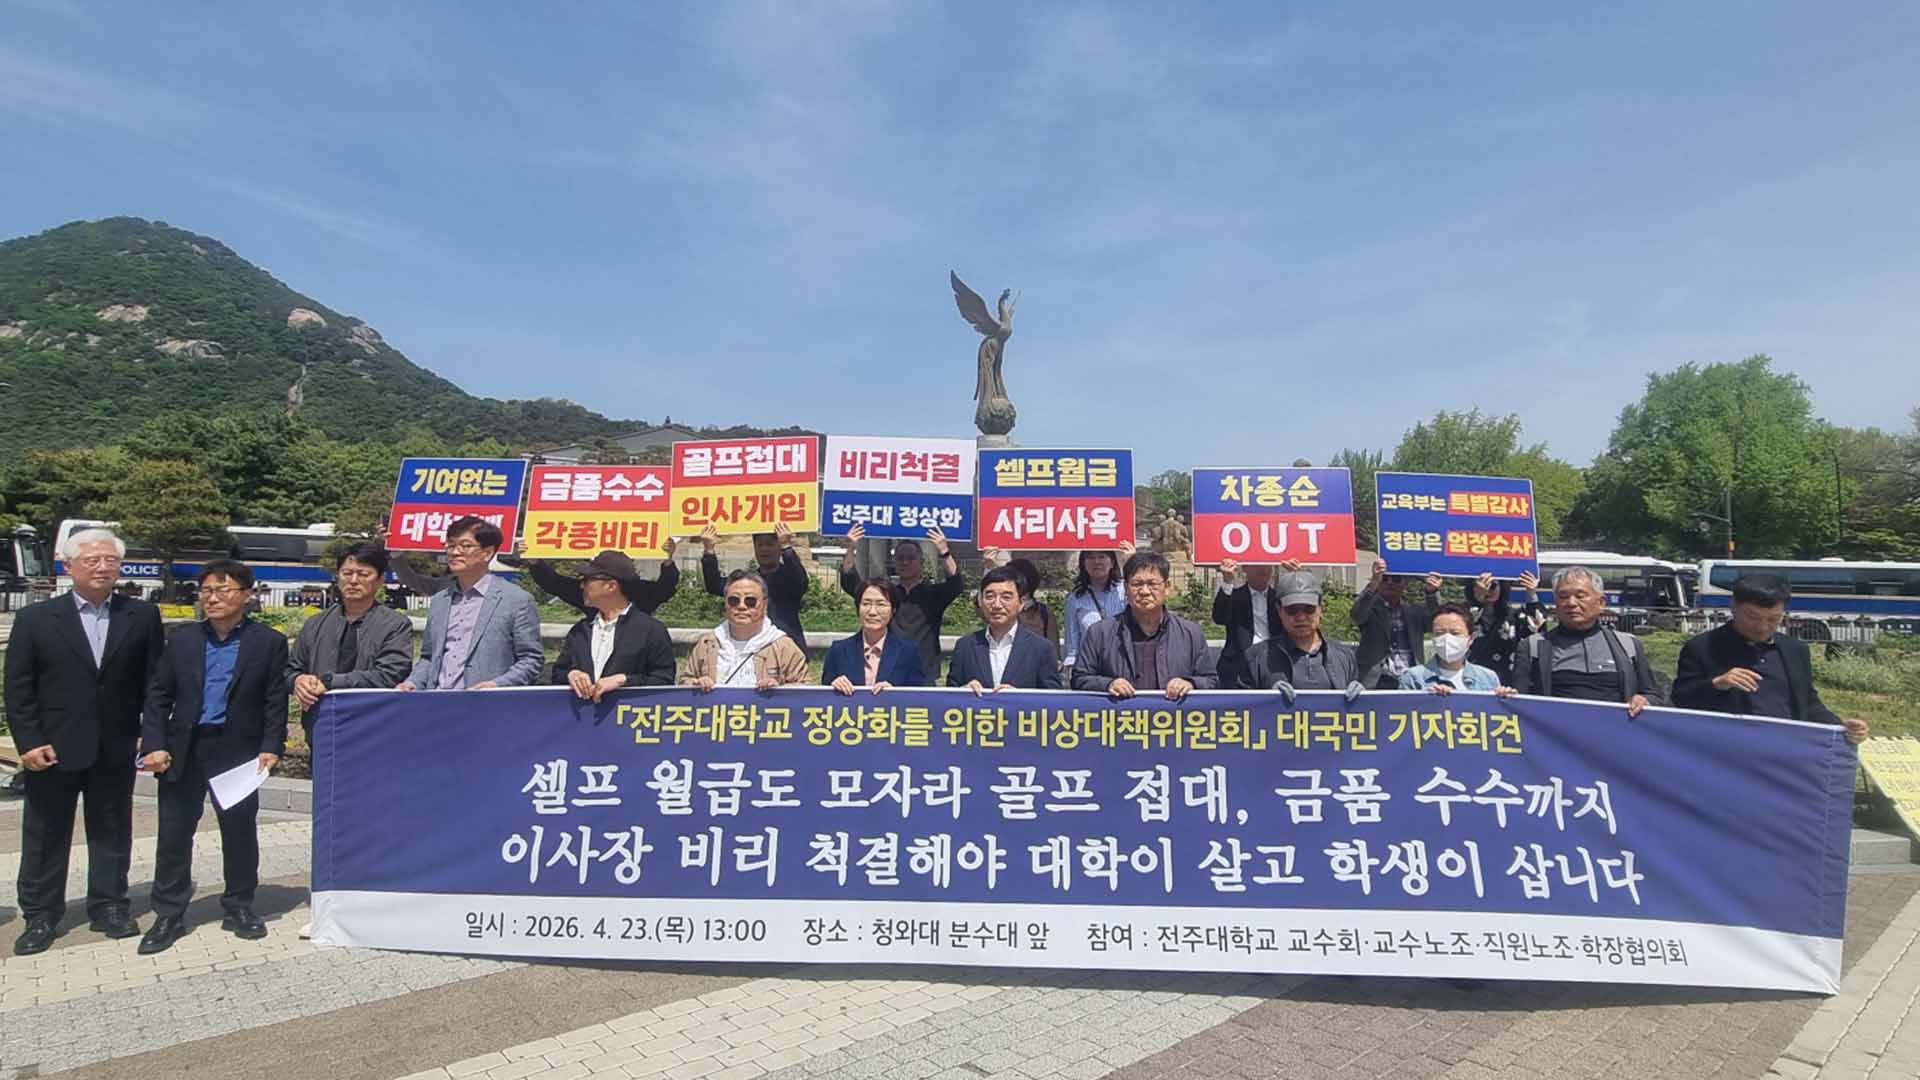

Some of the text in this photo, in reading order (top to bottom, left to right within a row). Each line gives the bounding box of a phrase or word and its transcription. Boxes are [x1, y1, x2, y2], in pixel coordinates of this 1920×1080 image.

[683, 443, 807, 477] 골프접대
[840, 451, 959, 483] 비리척결
[995, 458, 1116, 486] 셀프월급
[412, 469, 507, 495] 기여없는
[541, 474, 664, 501] 금품수수
[1221, 476, 1320, 506] 차종순
[682, 493, 805, 526] 인사개입
[832, 504, 962, 530] 전주대 정상화
[1382, 494, 1528, 515] 교육부는 특별감사
[400, 512, 504, 543] 대학
[536, 521, 658, 552] 각종비리
[994, 507, 1119, 539] 사리사욕
[1222, 522, 1325, 553] OUT
[1384, 531, 1532, 557] 경찰은 엄정수사
[121, 565, 159, 575] OLICE
[802, 706, 932, 746] 정상화를
[942, 708, 1008, 746] 위한
[1278, 711, 1377, 751] 대국민
[1388, 710, 1521, 753] 기자회견
[522, 759, 1616, 834] 셀프 월급도 모자라 골프 접대, 금품 수수까지
[502, 825, 1644, 904] 이사장 비리 척결해야 대학이 살고 학생이 삽니다
[466, 912, 504, 938] 일시
[525, 916, 584, 938] 2026.
[593, 918, 611, 939] 4.
[621, 917, 694, 943] 23.(목)
[704, 919, 766, 941] 13:00
[804, 918, 848, 945] 장소
[872, 919, 939, 946] 청와대
[949, 921, 1017, 948] 분수대
[1027, 922, 1049, 950] 앞
[1088, 924, 1132, 951] 참여
[1158, 925, 1278, 954] 전주대학교
